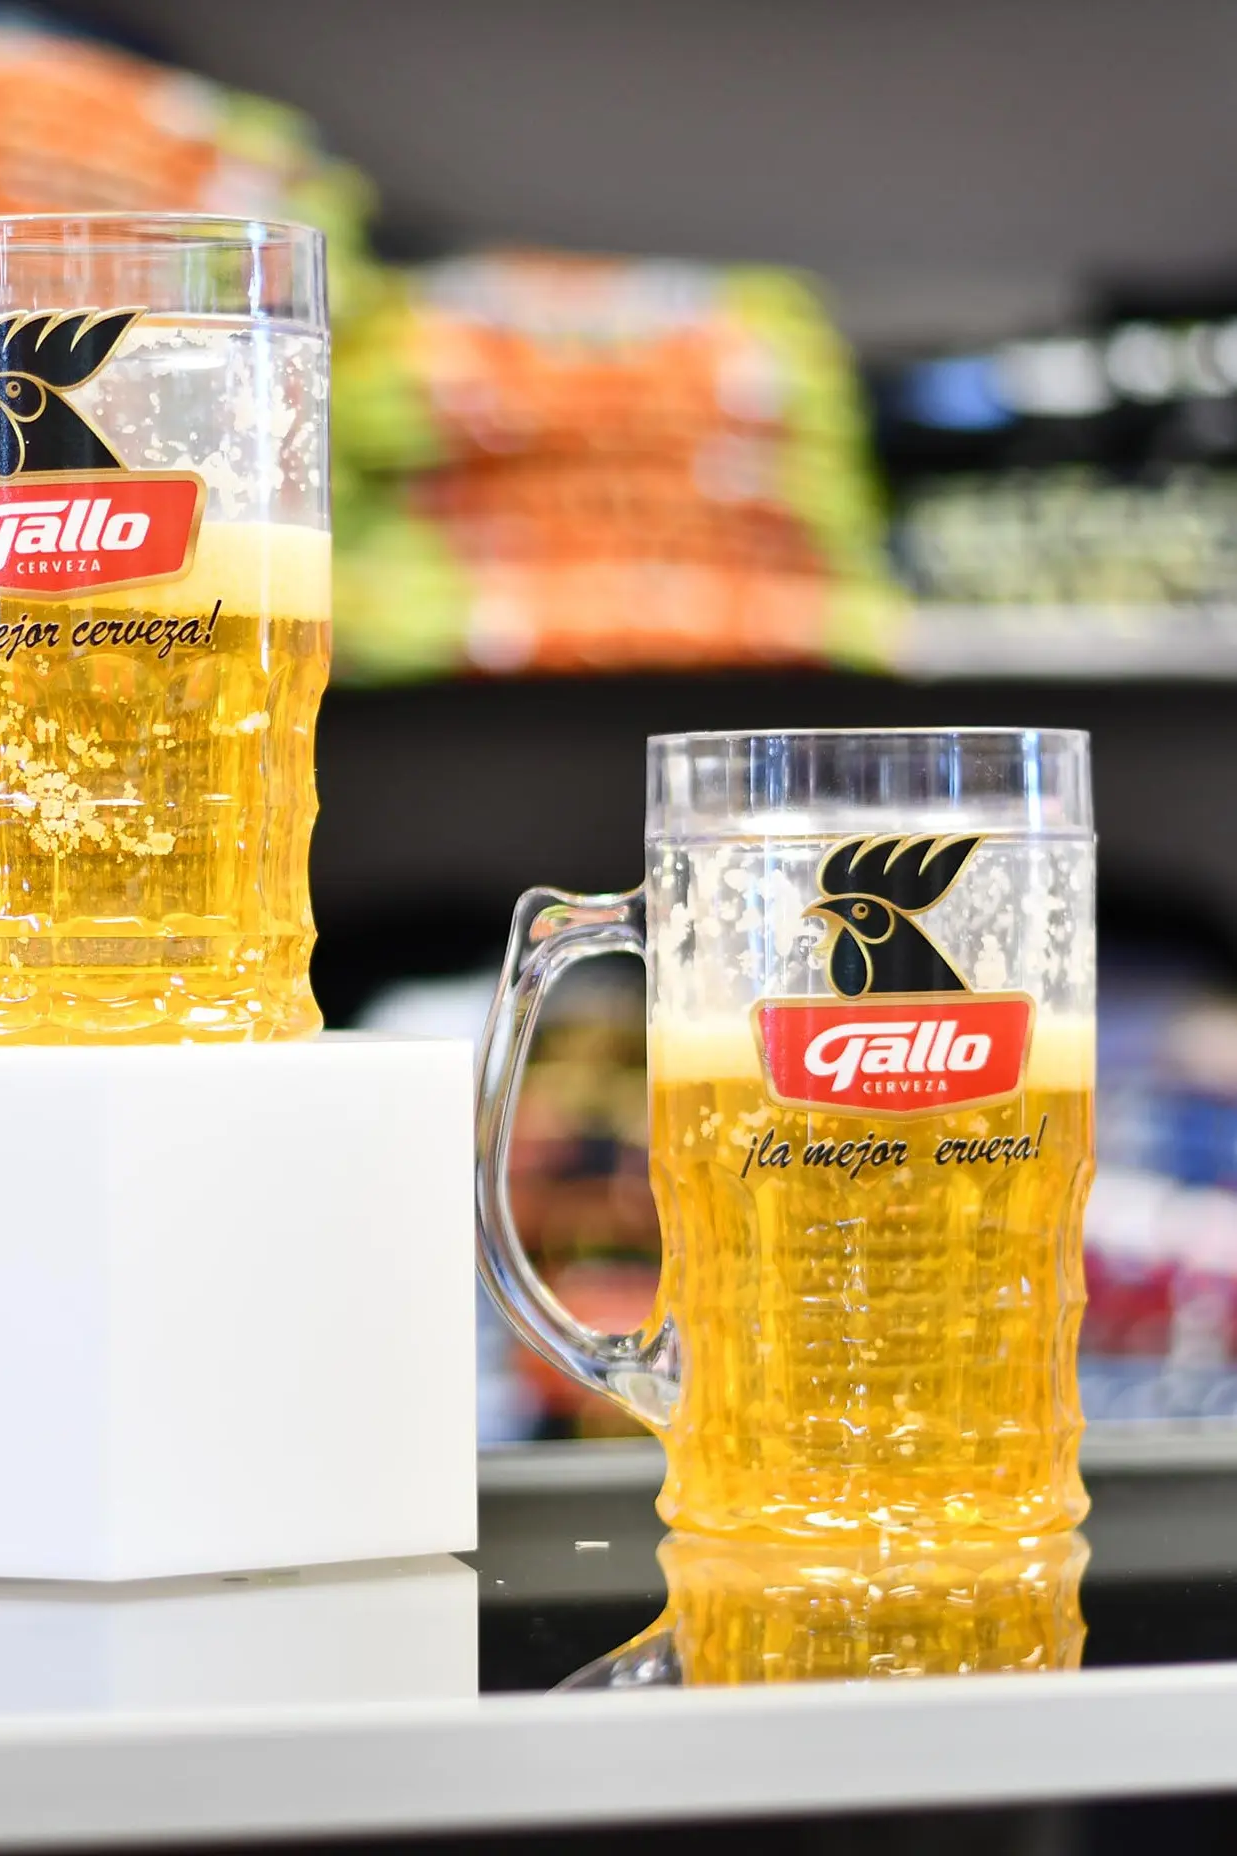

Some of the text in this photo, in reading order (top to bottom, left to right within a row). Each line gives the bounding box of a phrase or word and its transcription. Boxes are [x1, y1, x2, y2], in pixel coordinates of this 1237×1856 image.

[16, 560, 100, 573] CERVEZA
[72, 600, 220, 657] cerveza!
[804, 1020, 990, 1090] Gallo
[862, 1079, 946, 1093] CERVEZA
[803, 1131, 906, 1178] mejor
